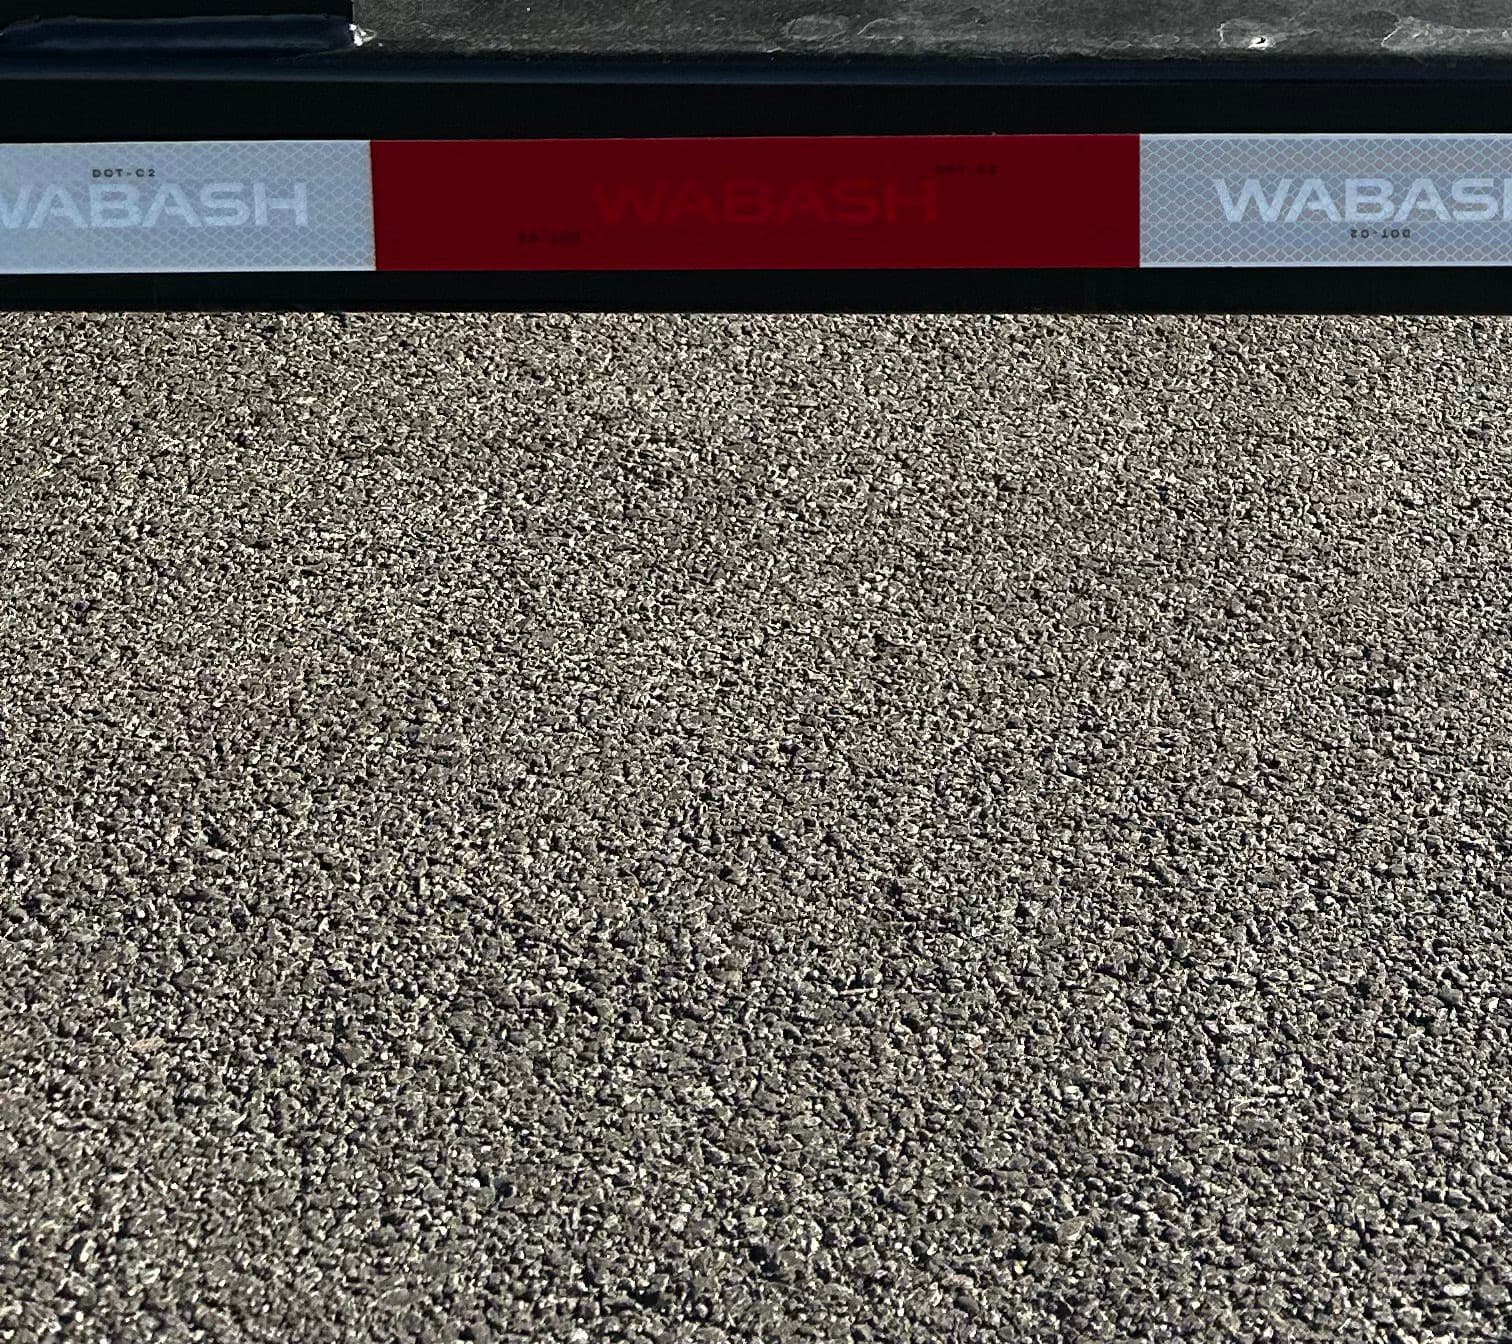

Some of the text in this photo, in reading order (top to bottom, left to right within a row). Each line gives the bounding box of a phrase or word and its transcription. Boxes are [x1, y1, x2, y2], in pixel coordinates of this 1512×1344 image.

[92, 168, 156, 179] DOT-C2
[592, 178, 938, 225] WABASH
[1350, 229, 1411, 240] DOT-C2
